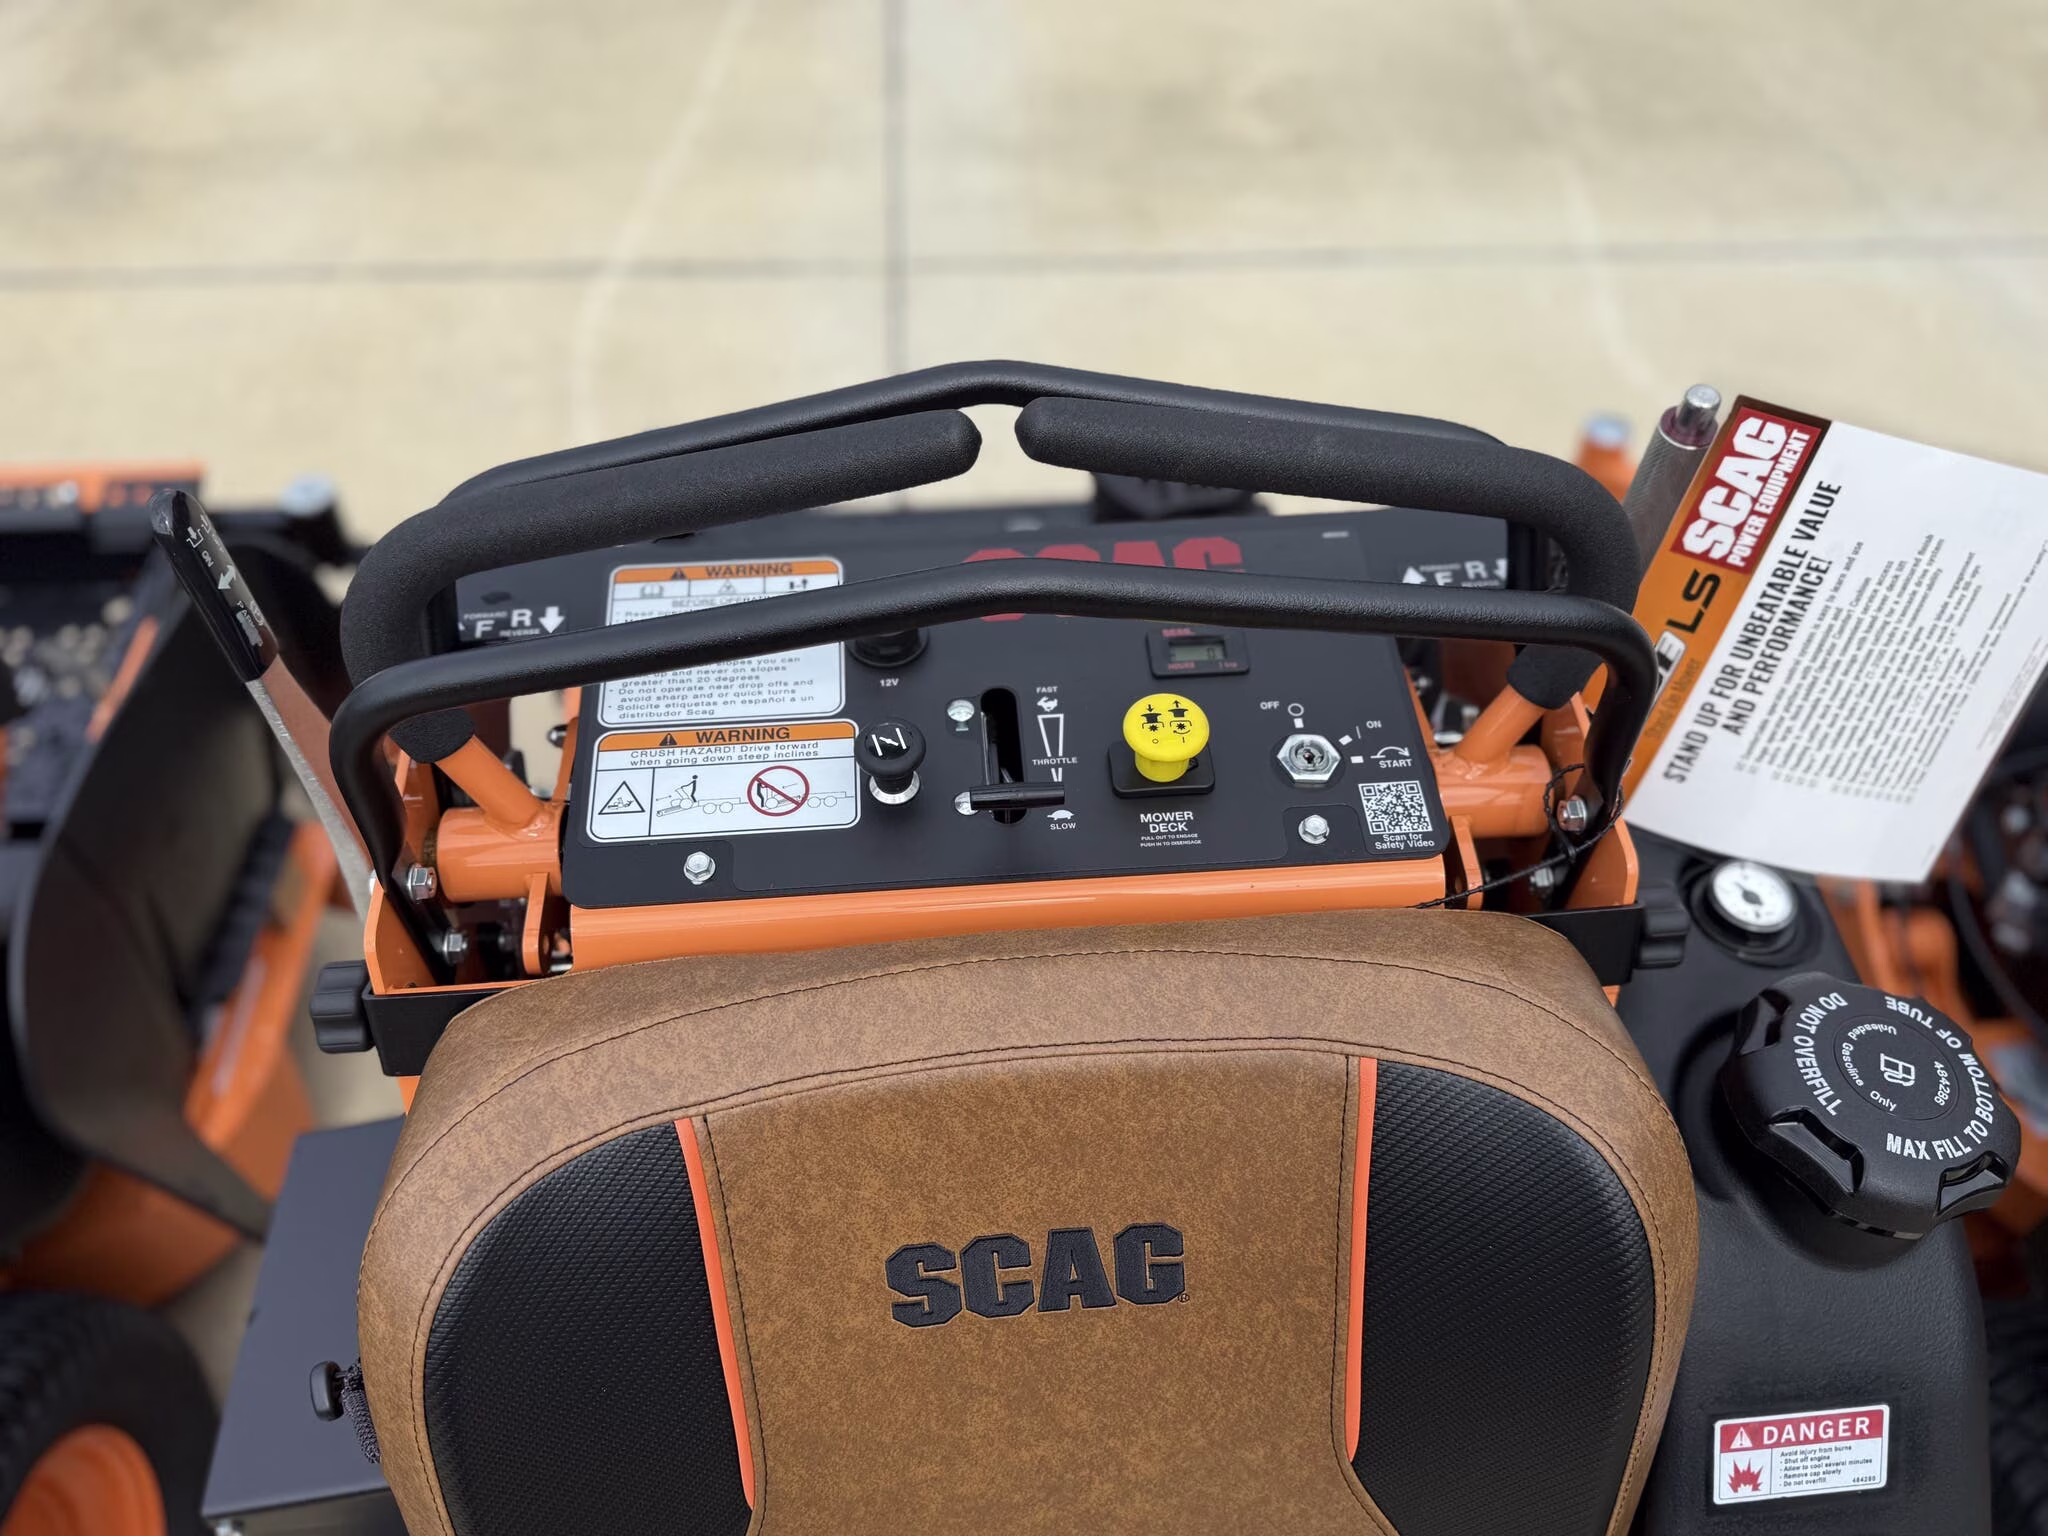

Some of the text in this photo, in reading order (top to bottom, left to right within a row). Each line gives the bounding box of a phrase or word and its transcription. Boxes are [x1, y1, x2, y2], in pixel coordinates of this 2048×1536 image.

[1682, 417, 1787, 561] SCAG
[1726, 428, 1811, 568] POWER EQUIPMENT
[201, 550, 214, 568] ON
[705, 563, 793, 578] WARNING
[1464, 561, 1488, 580] R
[1665, 568, 1721, 634] LS
[474, 608, 533, 639] F R
[1664, 730, 1708, 783] STAND
[1697, 701, 1723, 729] UP
[1710, 662, 1745, 700] FOR
[1730, 545, 1808, 660] UNBEATABLE
[1791, 480, 1842, 543] VALUE
[1722, 699, 1756, 736] AND
[1742, 556, 1833, 695] PERFORMANCE!
[696, 668, 729, 676] never
[750, 665, 787, 673] slopes
[621, 679, 663, 688] greater
[667, 676, 693, 684] than
[714, 673, 761, 682] degrees
[637, 686, 656, 694] not
[660, 685, 705, 694] operate
[708, 683, 734, 691] near
[738, 682, 764, 690] drop
[879, 677, 900, 687] 12V
[620, 695, 652, 703] avoid
[655, 693, 688, 702] sharp
[692, 691, 713, 700] and
[733, 688, 763, 697] quick
[1035, 685, 1058, 694] FAST
[617, 702, 660, 711] Solicite
[664, 699, 718, 709] etiquetas
[740, 696, 786, 705] español
[1259, 700, 1280, 711] OFF
[619, 708, 715, 719] distribudor Scag
[1365, 720, 1382, 730] ON
[695, 726, 791, 744] WARNING
[630, 741, 819, 759] CRUSH HAZARD! Drive forward
[630, 749, 819, 767] when going down steep inclines
[1031, 756, 1078, 766] THROTTLE
[1378, 758, 1413, 769] START
[1140, 810, 1194, 823] MOWER
[1049, 822, 1077, 830] SLOW
[1149, 821, 1188, 833] DECK
[1374, 840, 1435, 850] Safety Video
[1382, 834, 1407, 842] Scan
[1793, 991, 1849, 1116] DO NOT OVERFILL
[1841, 1022, 1898, 1112] Unleaded Gasoline Only
[1884, 995, 1996, 1161] MAX FILL TO BOTTOM OF TUBE
[884, 1222, 1187, 1329] SCAG
[1762, 1416, 1870, 1445] DANGER
[1799, 1448, 1817, 1456] injury
[1805, 1477, 1827, 1485] overfill
